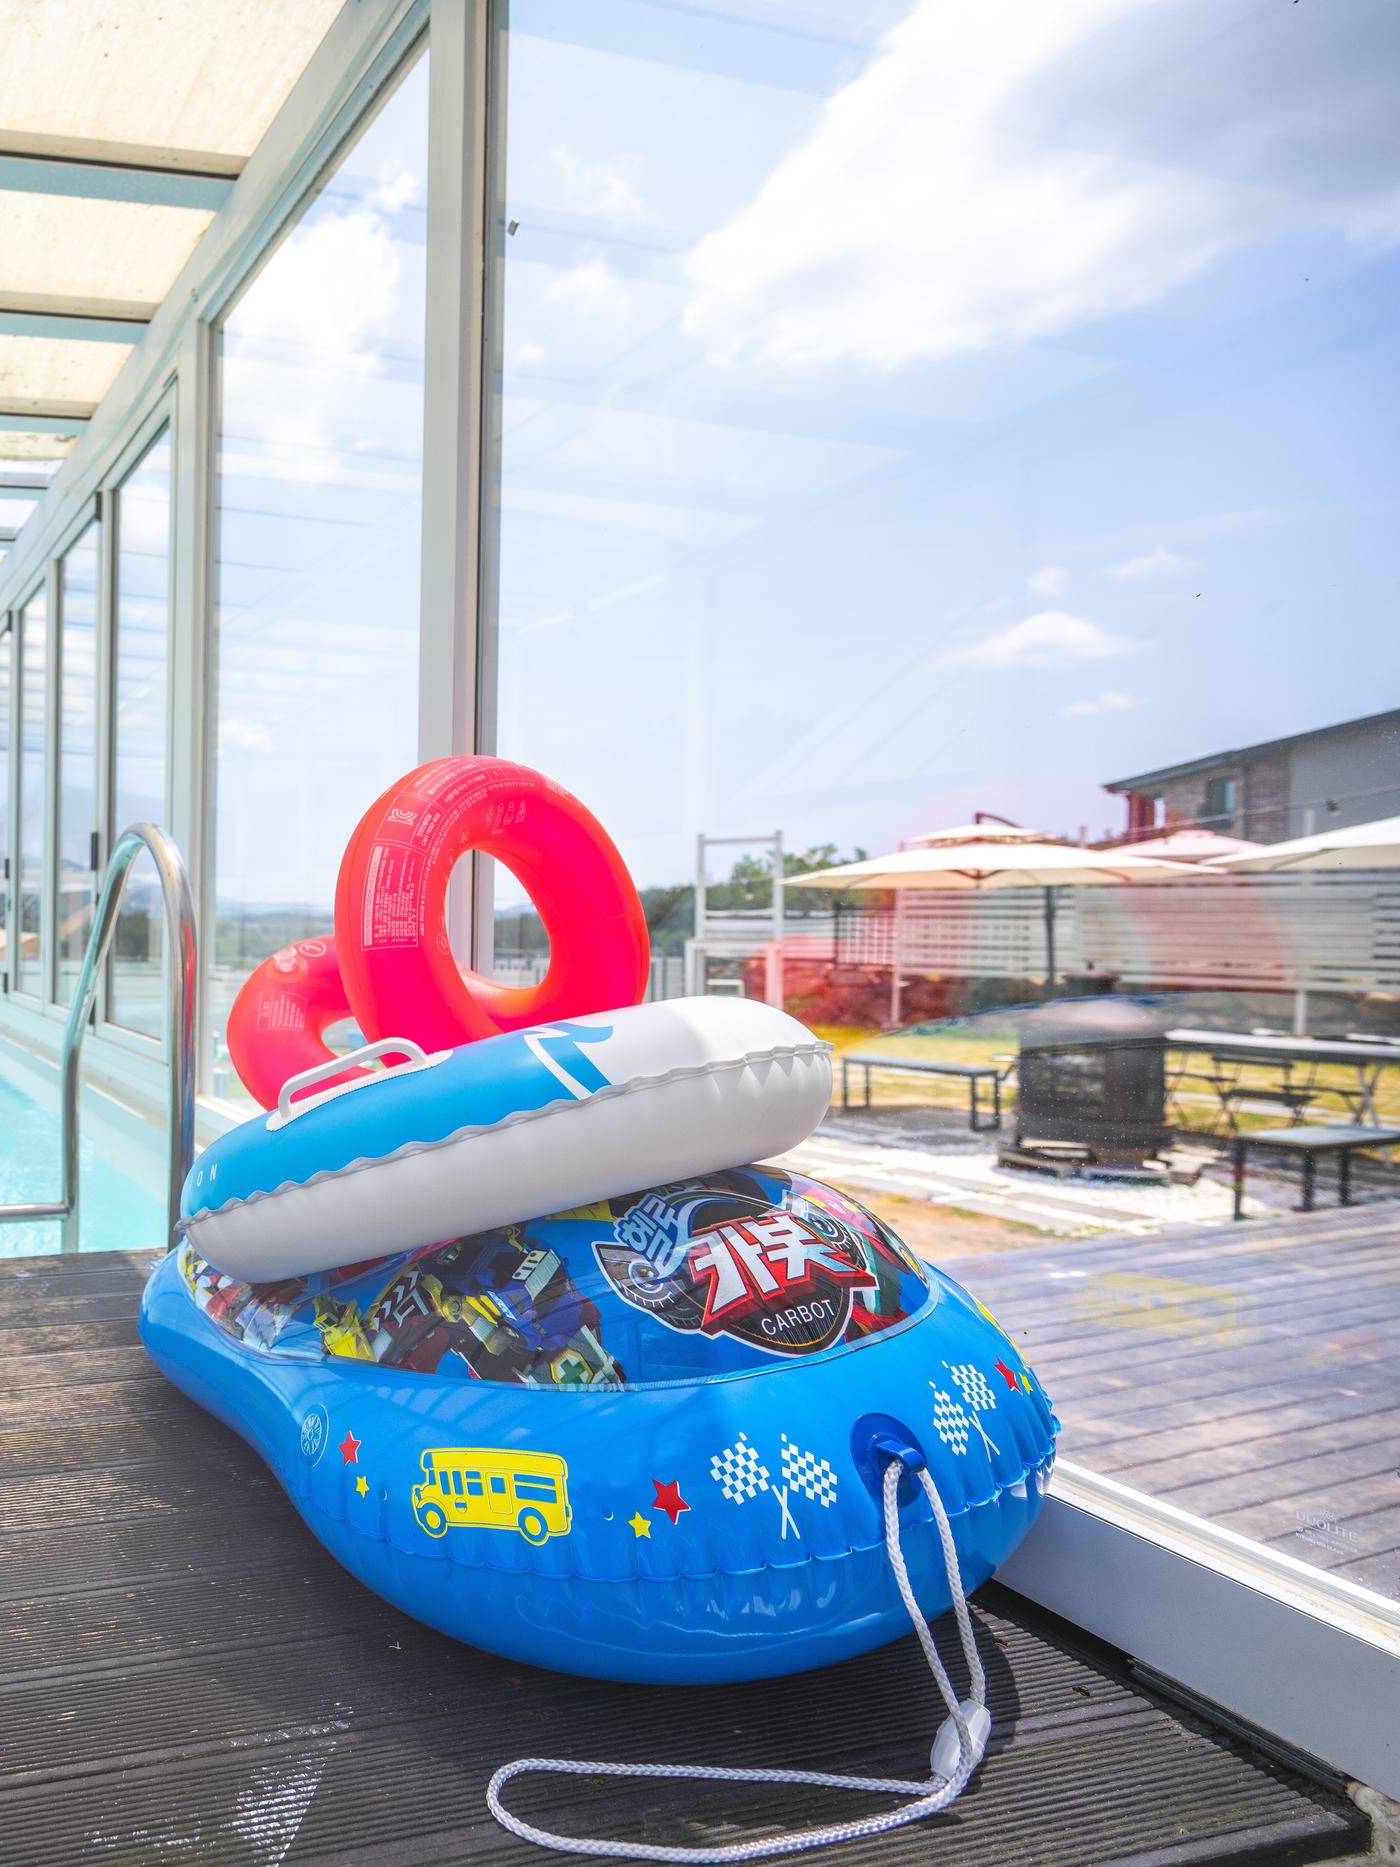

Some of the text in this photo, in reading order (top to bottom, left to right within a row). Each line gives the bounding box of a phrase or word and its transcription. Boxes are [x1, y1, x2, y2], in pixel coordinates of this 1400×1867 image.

[620, 1194, 692, 1281] 헬로
[692, 1213, 864, 1316] 카봇
[760, 1298, 836, 1337] CARBOT
